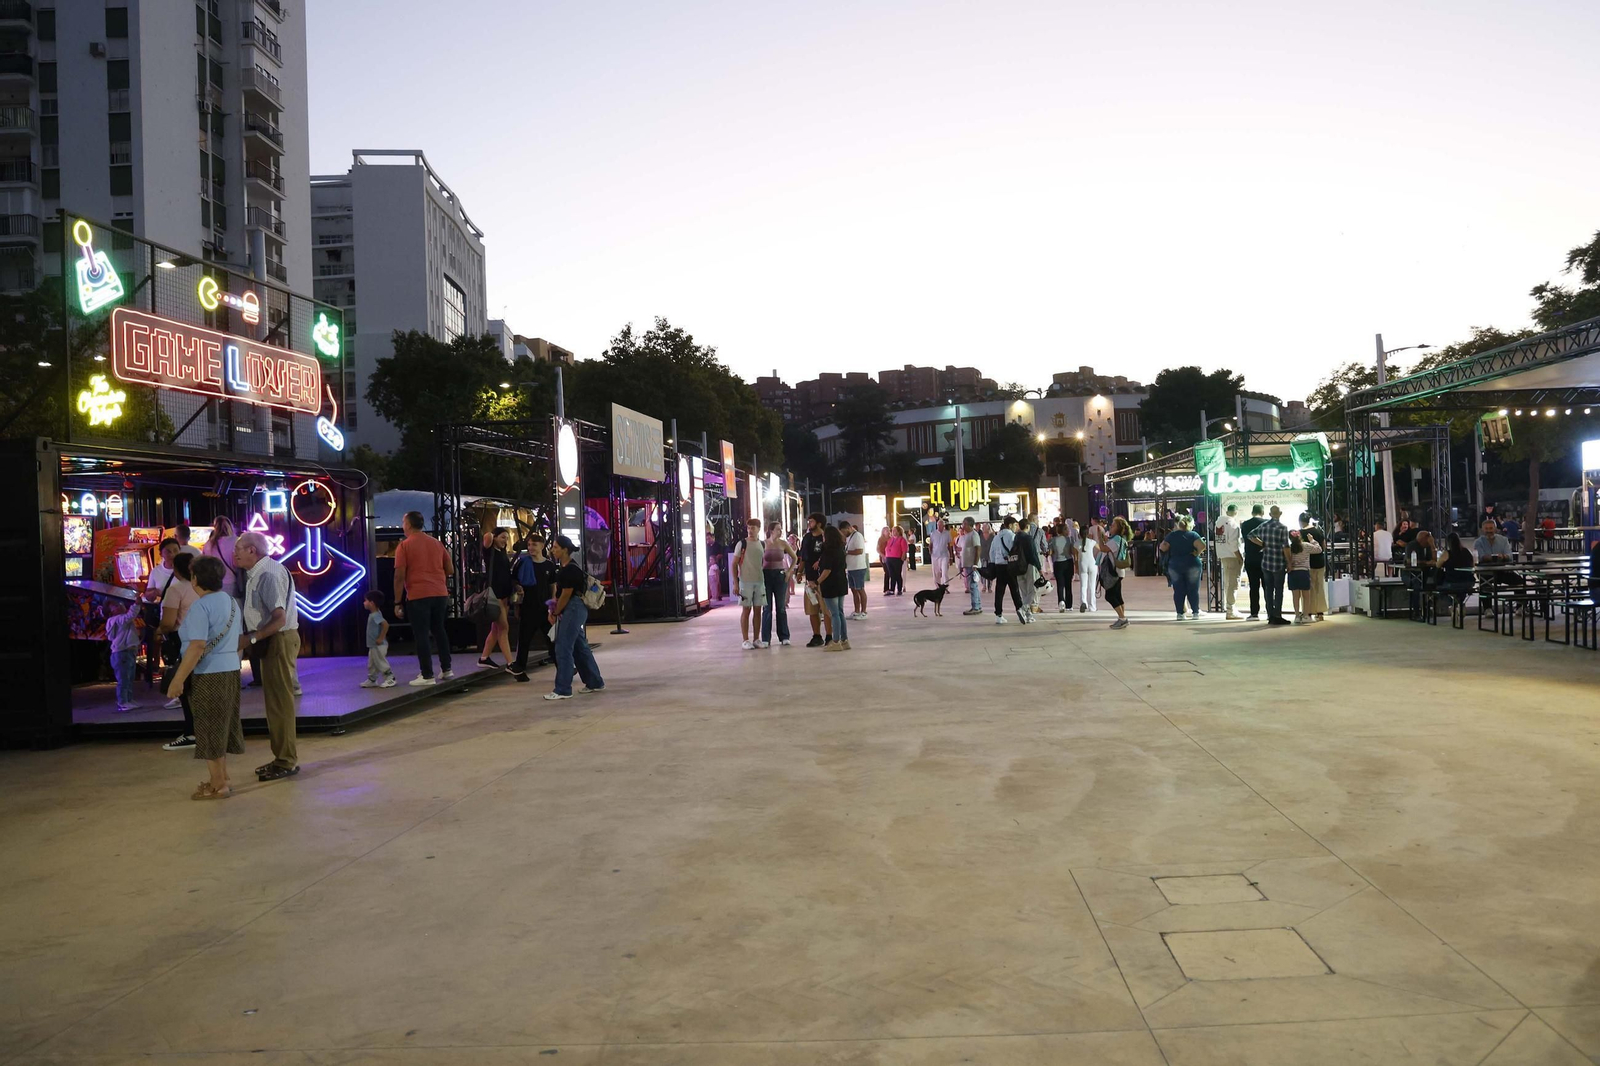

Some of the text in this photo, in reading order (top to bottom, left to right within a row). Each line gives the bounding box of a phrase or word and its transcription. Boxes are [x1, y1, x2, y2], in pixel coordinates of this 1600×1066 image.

[123, 320, 316, 405] GAME LOVER
[930, 478, 992, 511] EL POBLE
[1207, 471, 1261, 494] Uber
[1262, 468, 1318, 491] Eats
